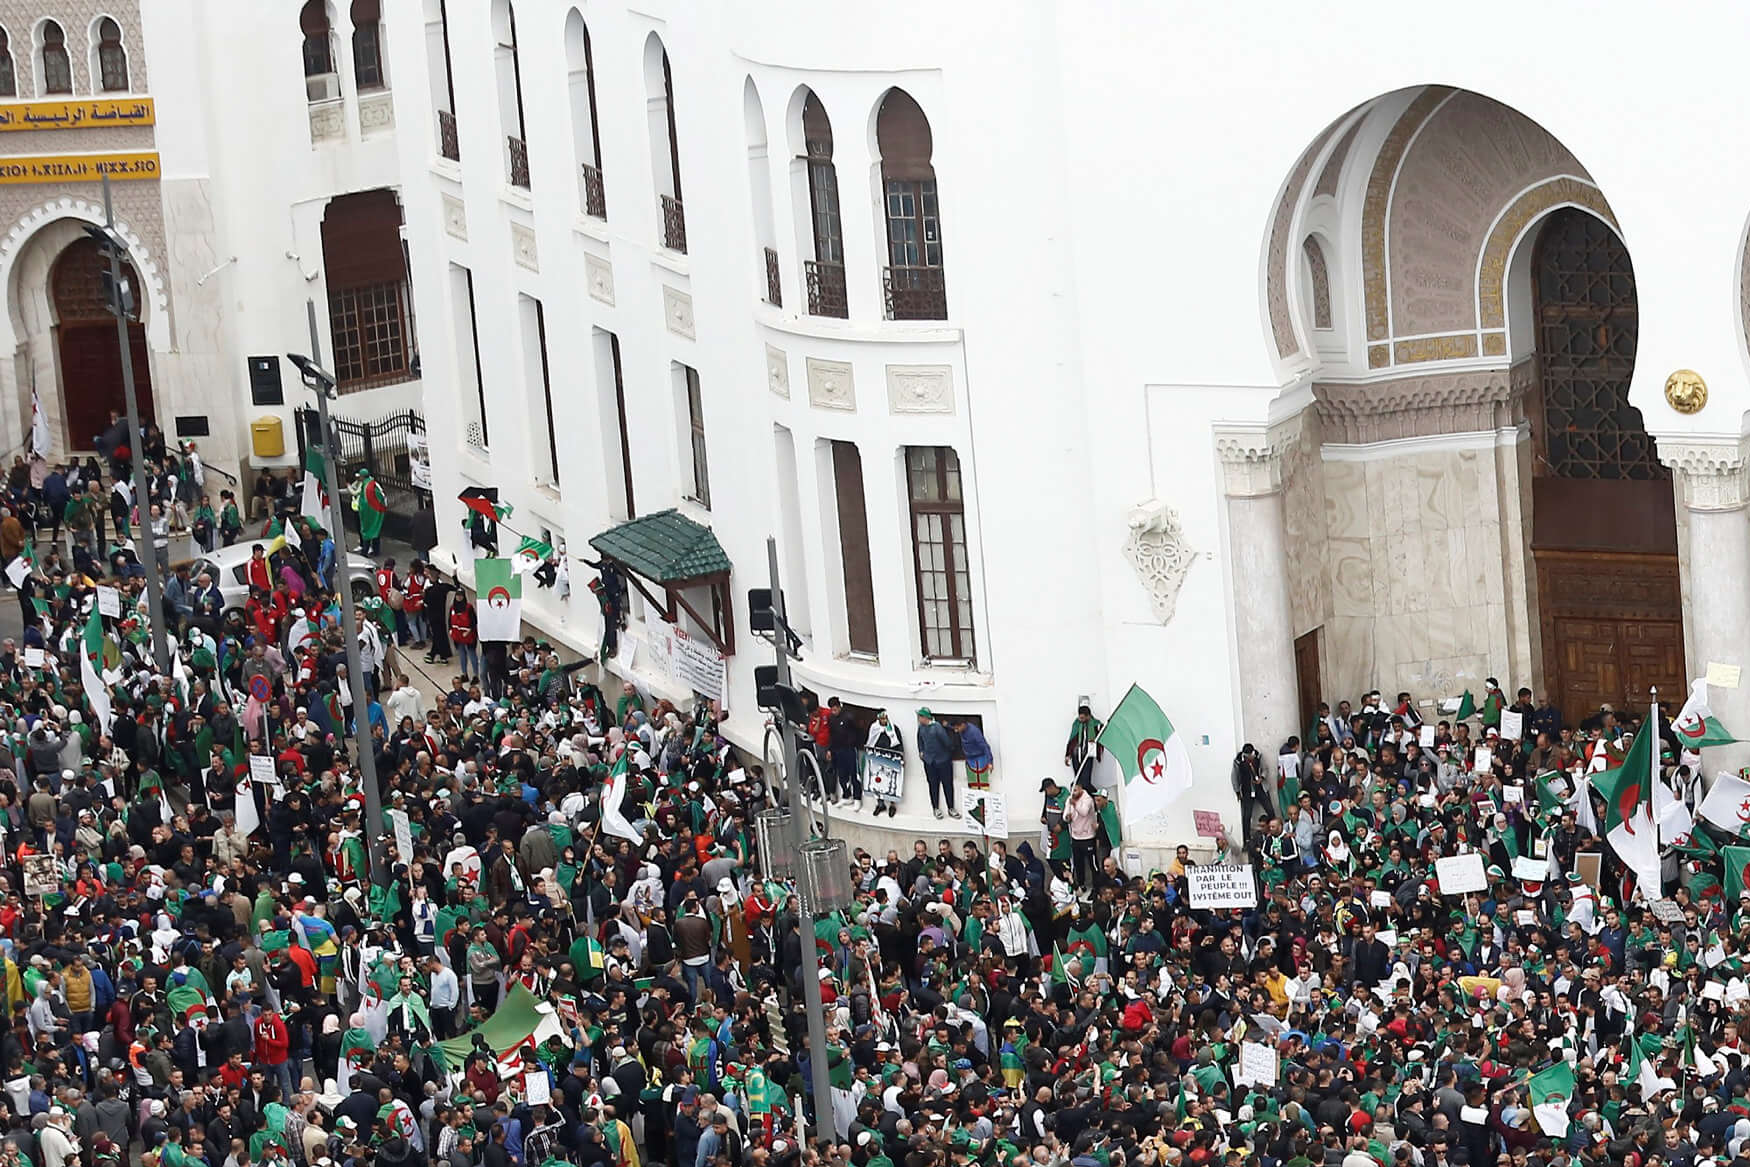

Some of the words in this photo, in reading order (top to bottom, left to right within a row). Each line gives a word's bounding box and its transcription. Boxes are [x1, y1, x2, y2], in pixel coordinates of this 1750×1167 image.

[1196, 874, 1215, 883] PAR
[1221, 873, 1232, 882] LE
[1200, 881, 1237, 891] PEUPLE
[1233, 891, 1252, 899] OUT
